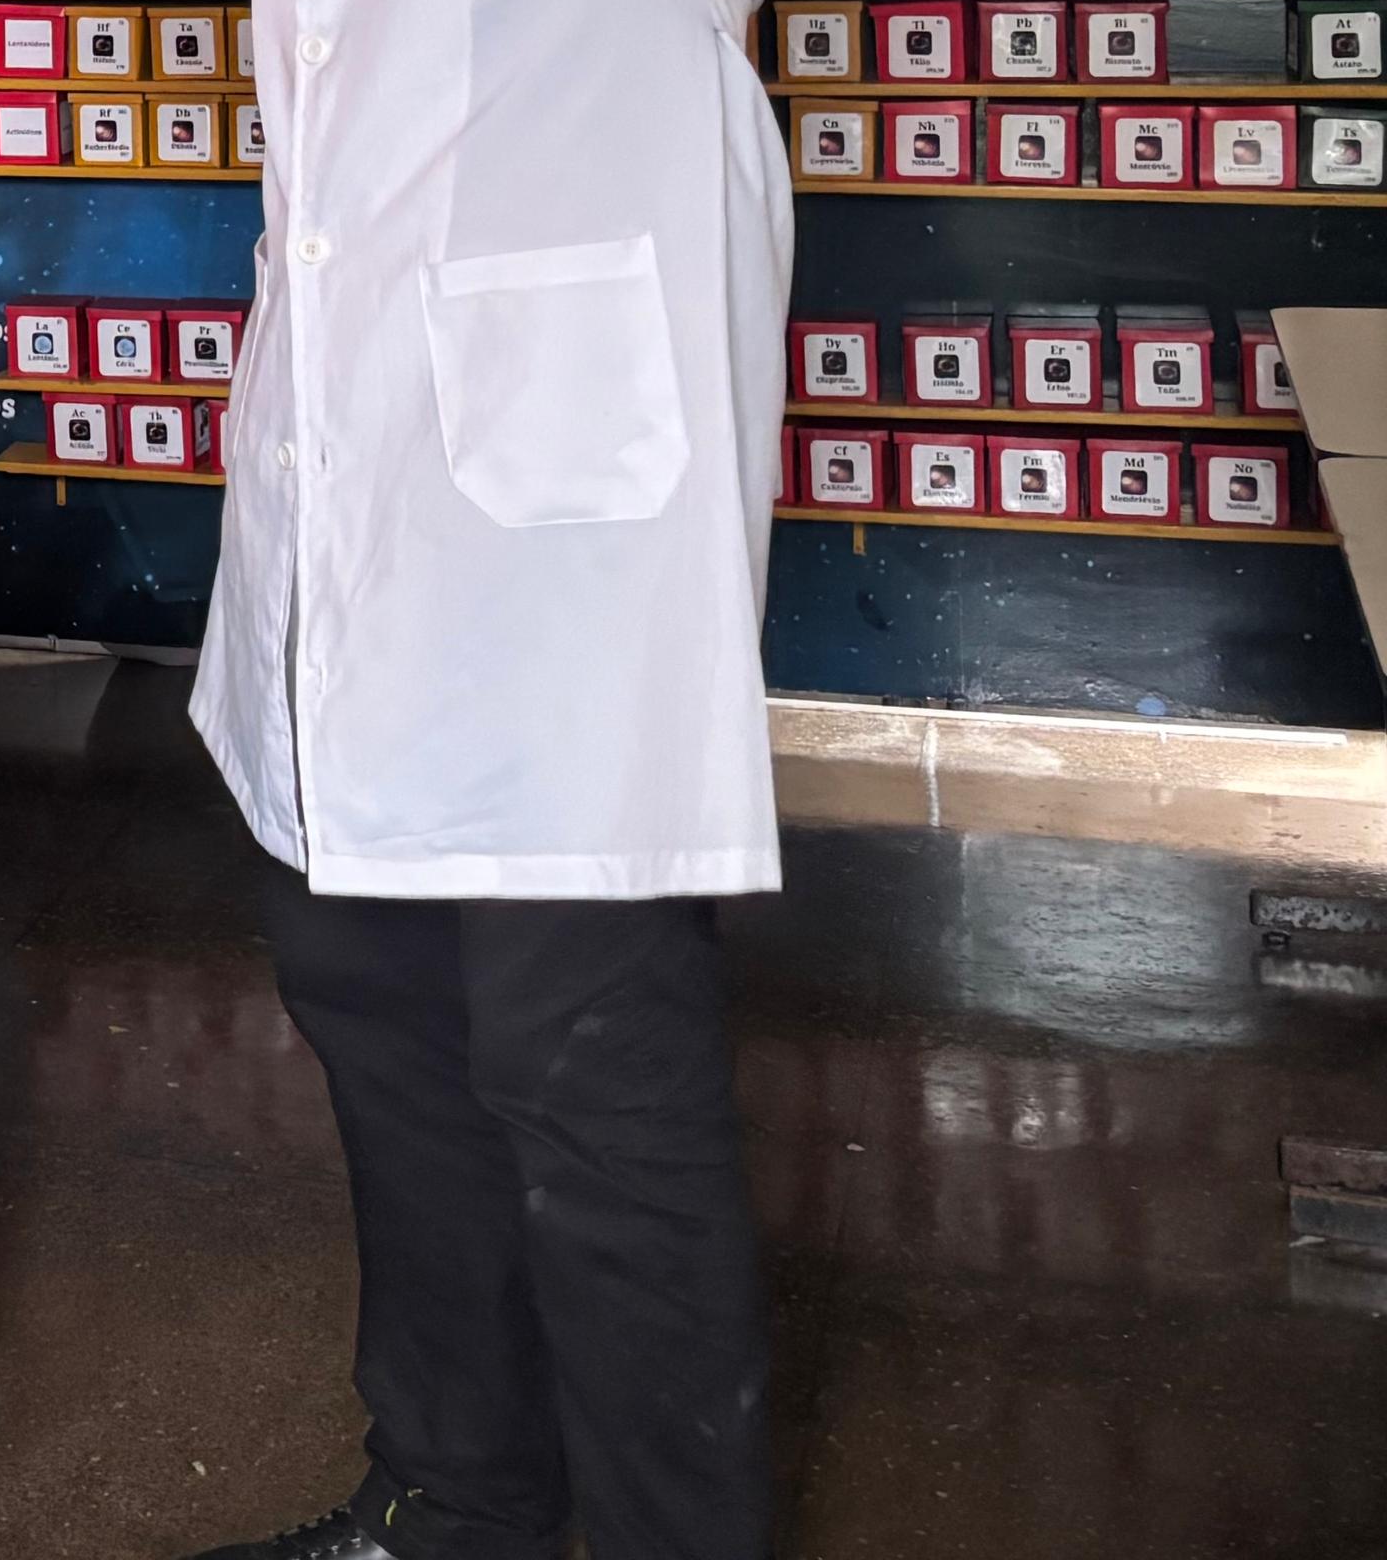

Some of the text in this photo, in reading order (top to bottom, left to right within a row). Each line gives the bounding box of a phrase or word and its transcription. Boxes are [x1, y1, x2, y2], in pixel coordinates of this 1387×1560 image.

[97, 23, 111, 32] Hf
[179, 23, 193, 32] Ta
[1017, 18, 1032, 28] Pb
[1115, 19, 1127, 28] Bi
[1336, 19, 1351, 28] At
[100, 109, 112, 118] Rf
[175, 109, 190, 118] Db
[823, 120, 838, 128] Cn
[918, 122, 936, 131] Nh
[1139, 124, 1157, 134] Mc
[1342, 128, 1357, 137] Ts
[36, 321, 49, 331] La
[1050, 345, 1066, 355] Er
[1124, 457, 1145, 469] Md
[1234, 463, 1252, 474] No
